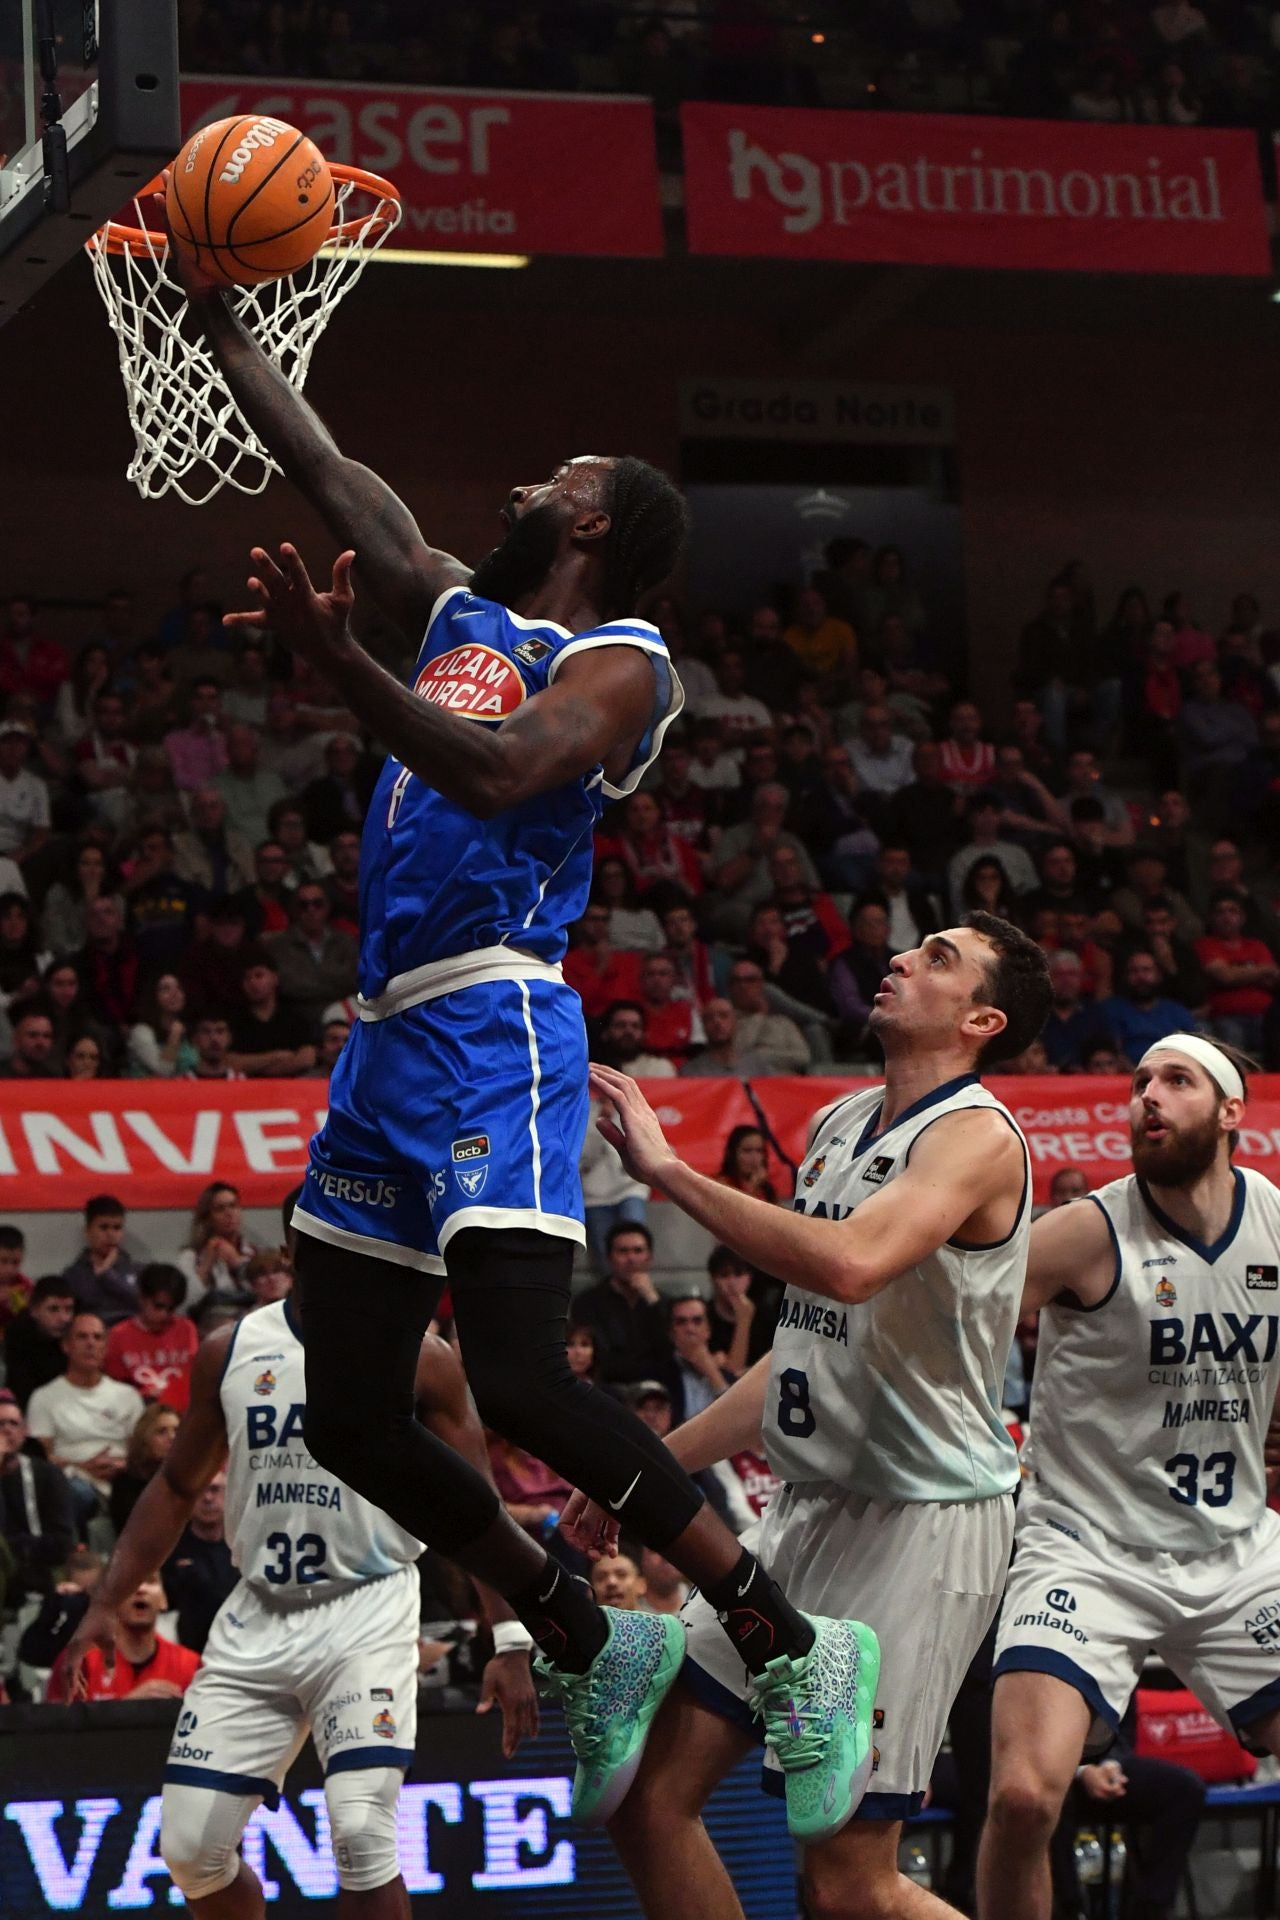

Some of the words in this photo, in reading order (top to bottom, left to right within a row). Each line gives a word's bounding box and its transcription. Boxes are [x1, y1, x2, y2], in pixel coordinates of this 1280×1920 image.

[252, 96, 510, 175] aser
[827, 149, 1225, 225] patrimonial
[692, 385, 817, 421] Grada
[834, 392, 943, 428] Norte
[433, 649, 511, 689] UCAM
[416, 680, 503, 714] MURCIA
[1016, 1105, 1090, 1128] Costa
[1094, 1102, 1131, 1124] Ca
[456, 1145, 481, 1159] acb
[1028, 1131, 1133, 1162] REG
[1238, 1129, 1280, 1157] D
[1149, 1313, 1279, 1366] BAXI
[777, 1367, 816, 1438] 8
[1162, 1398, 1249, 1429] MANRESA
[256, 1482, 341, 1512] MANRESA
[1165, 1451, 1237, 1508] 33
[264, 1531, 330, 1585] 32
[1013, 1610, 1090, 1645] unilabor
